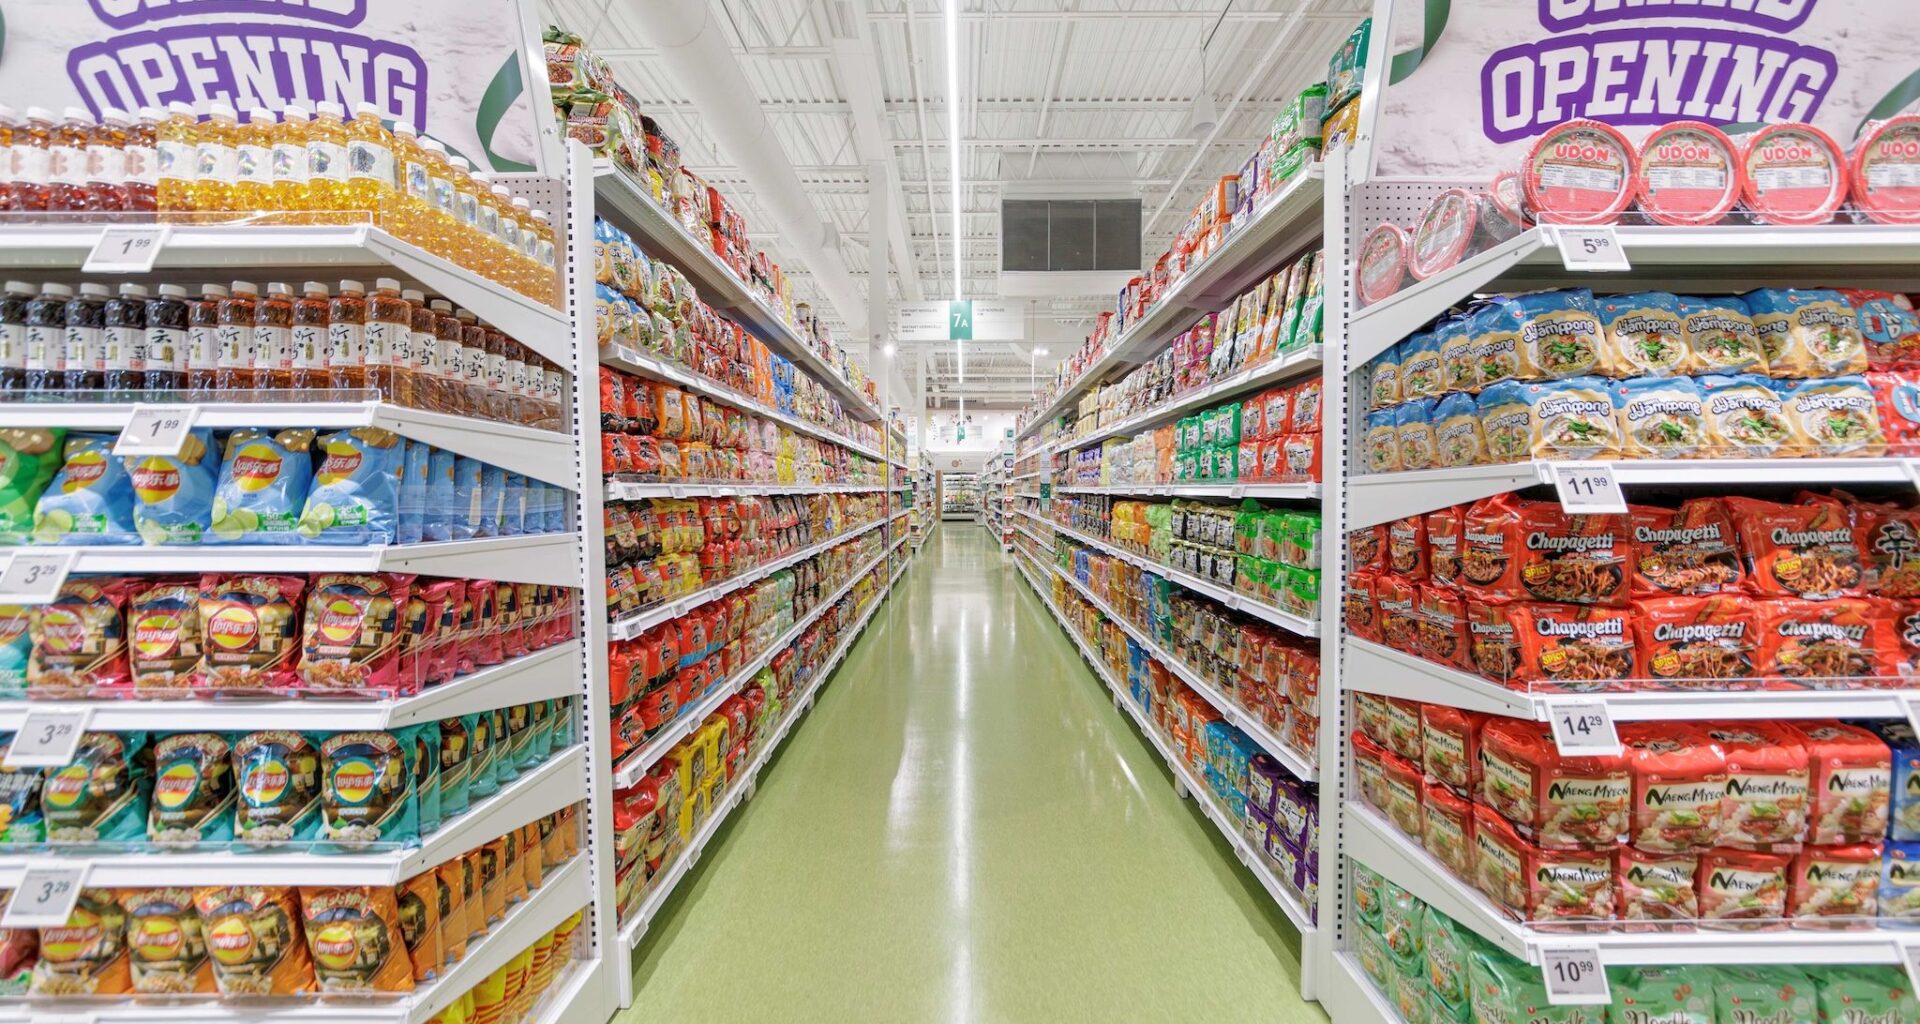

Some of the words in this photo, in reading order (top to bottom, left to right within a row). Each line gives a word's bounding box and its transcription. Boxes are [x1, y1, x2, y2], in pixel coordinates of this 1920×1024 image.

[77, 36, 417, 124] OPENING
[1491, 39, 1828, 132] OPENING
[1555, 144, 1610, 162] UDON
[1657, 144, 1711, 160] UDON
[1763, 146, 1812, 162] UDON
[1880, 142, 1920, 158] UDO
[1526, 531, 1614, 552] Chapagetti
[1635, 521, 1720, 545] Chapagetti
[1771, 527, 1852, 545] Chapagetti
[1524, 564, 1551, 577] SPICY
[1775, 559, 1802, 573] SPICY
[1537, 616, 1624, 639] Chapagetti
[1654, 620, 1746, 643] Chapagetti
[1778, 619, 1868, 641] Chapagetti
[1541, 650, 1568, 665] SPICY
[1653, 653, 1680, 669] SPICY
